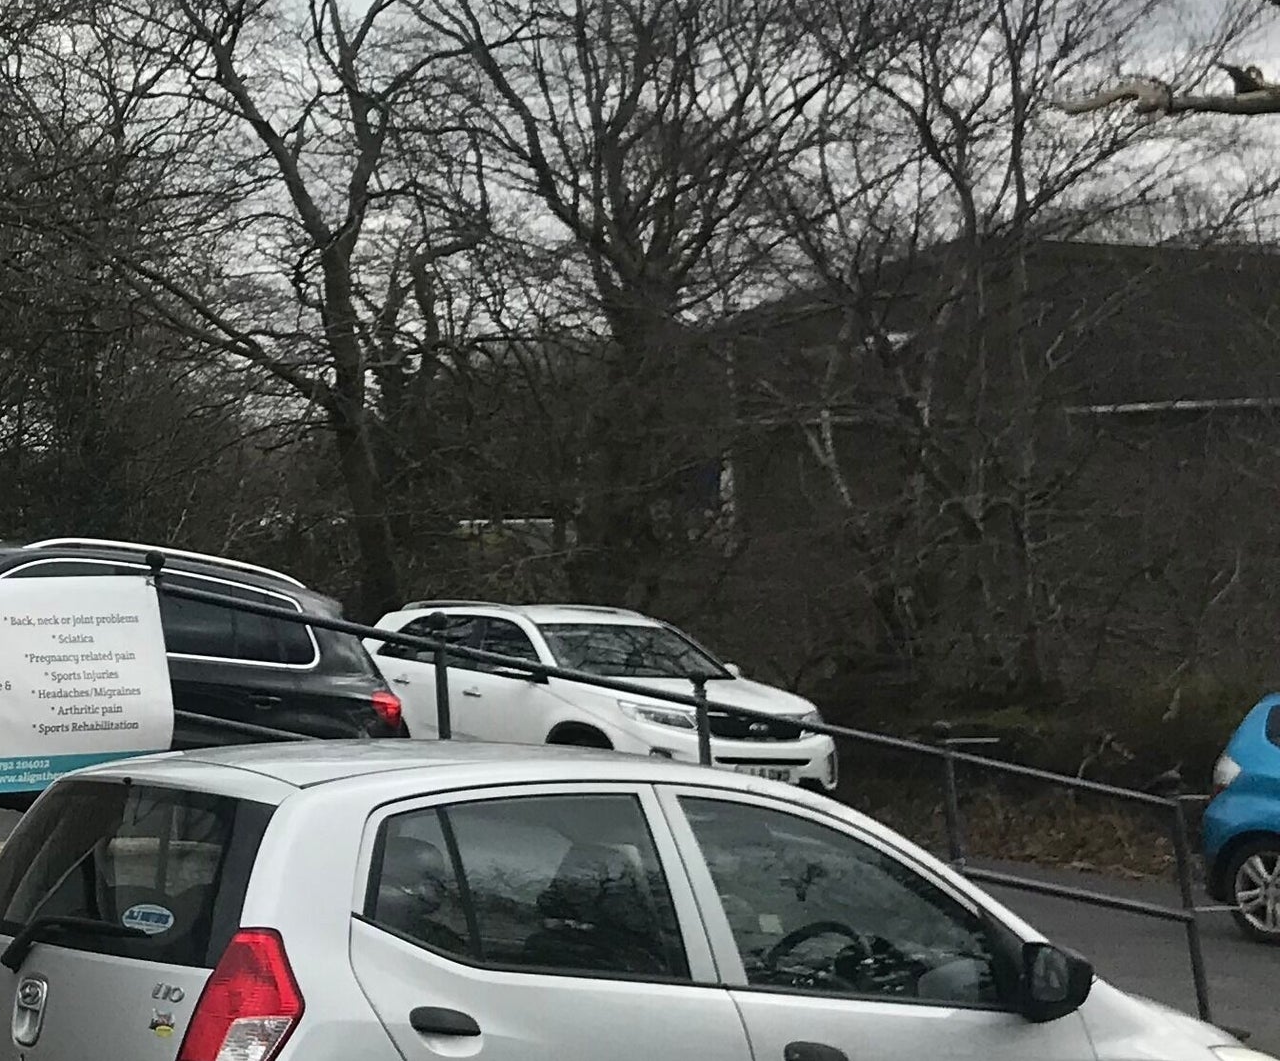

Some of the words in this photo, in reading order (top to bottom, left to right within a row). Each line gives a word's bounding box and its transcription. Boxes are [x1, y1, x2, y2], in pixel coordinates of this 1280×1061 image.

[37, 615, 60, 626] neck
[61, 617, 72, 625] or
[72, 614, 94, 627] joint
[96, 613, 139, 626] problems
[58, 633, 95, 644] Sciatica
[29, 652, 79, 666] Pregnancy
[81, 651, 114, 662] related
[115, 651, 136, 663] pain
[51, 670, 82, 684] Sports
[83, 669, 120, 682] Injuries
[4, 680, 12, 691] &
[38, 686, 142, 700] Headaches/Migraines
[57, 703, 100, 716] Arthritic
[101, 703, 123, 717] pain
[38, 722, 70, 736] Sports
[71, 719, 139, 734] Rehabilitation
